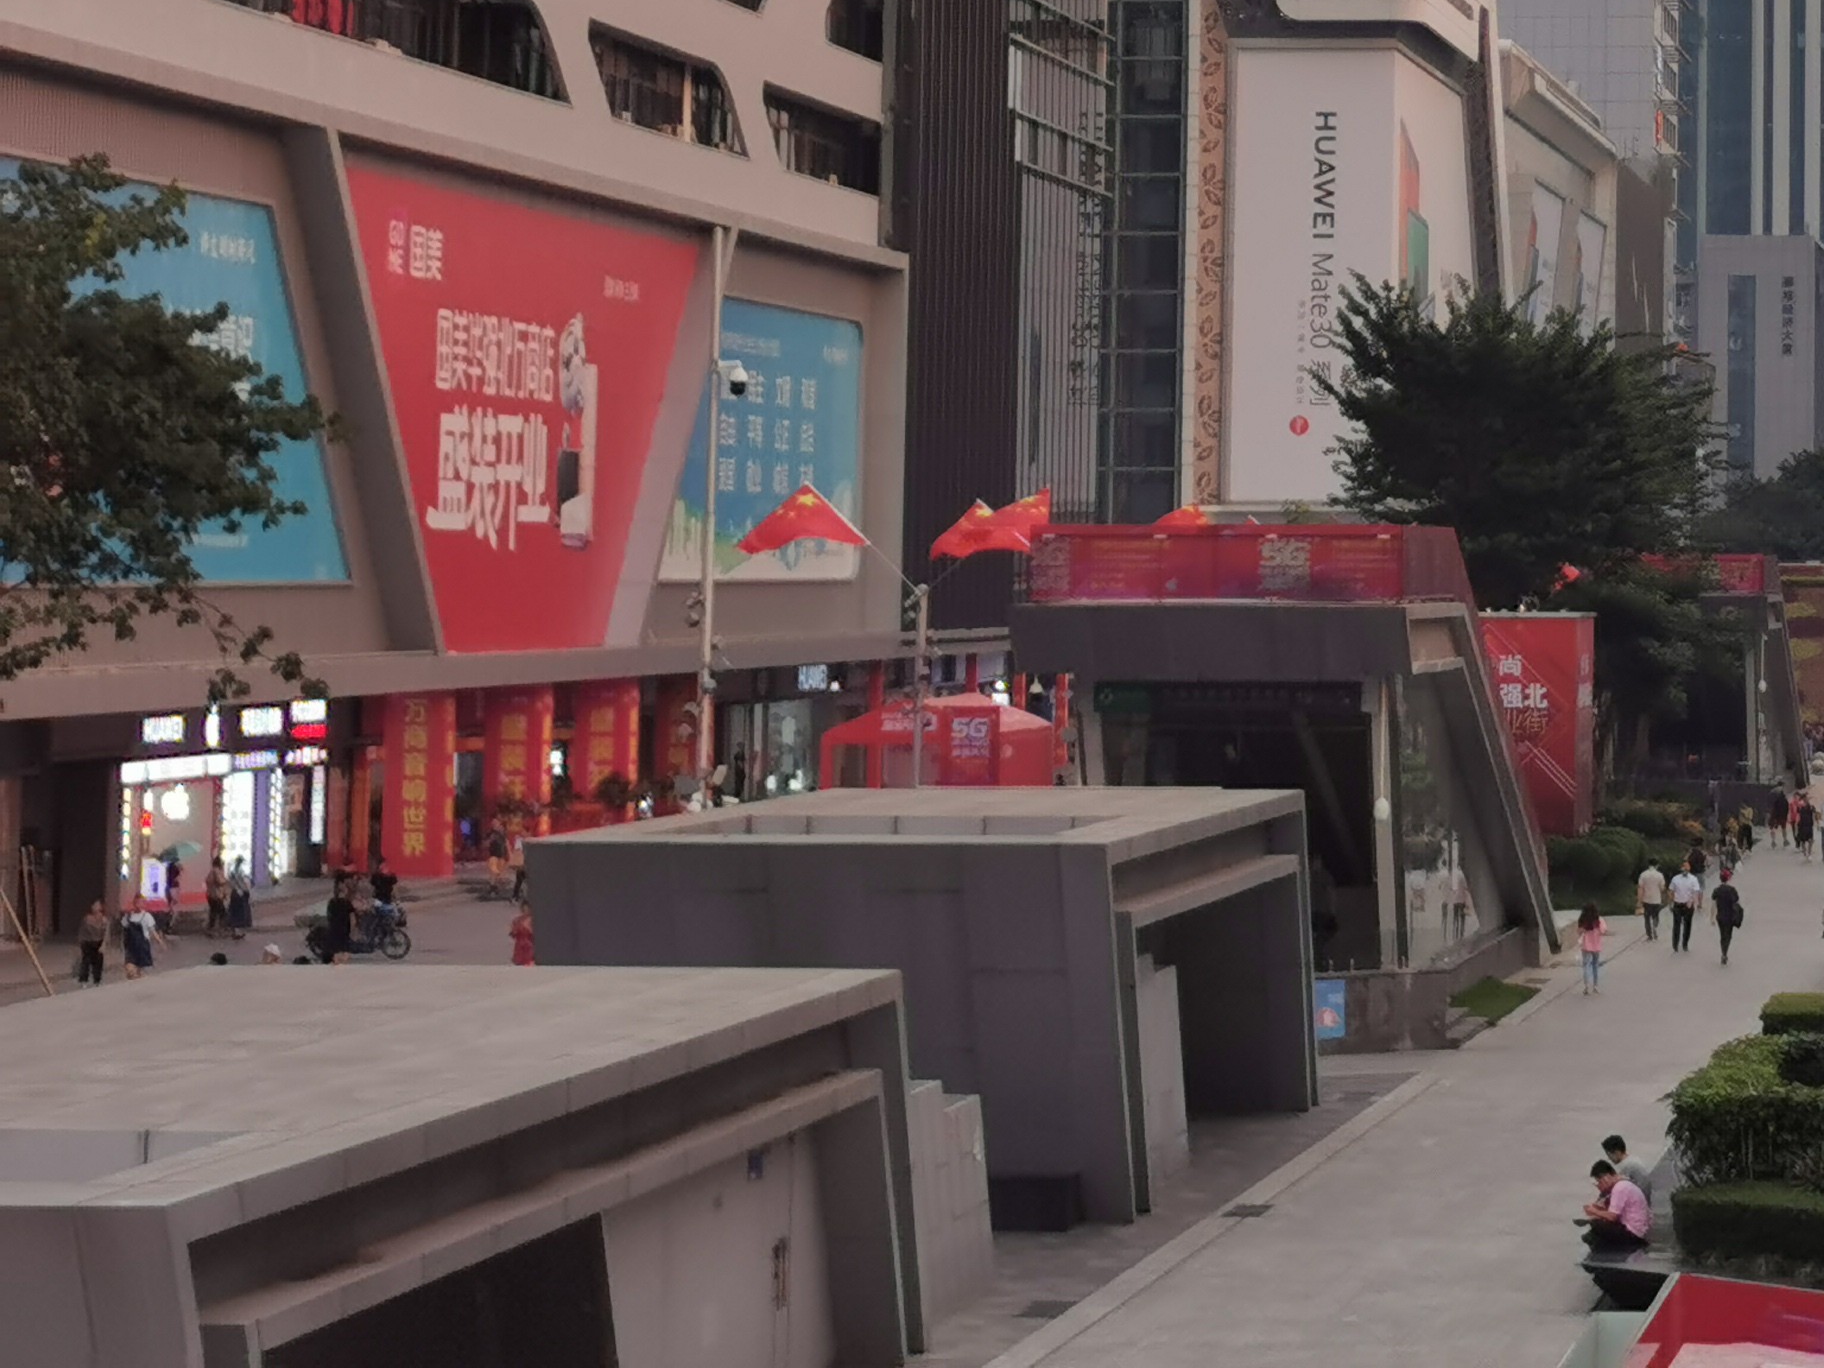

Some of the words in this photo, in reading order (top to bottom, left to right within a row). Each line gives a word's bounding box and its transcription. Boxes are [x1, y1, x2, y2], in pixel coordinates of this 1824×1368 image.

[1312, 111, 1337, 240] HUAWEI
[410, 224, 443, 281] 国美
[1310, 252, 1334, 350] Mate30
[435, 308, 556, 402] 国美华强北万商店
[425, 404, 551, 550] 盛装开业
[951, 717, 991, 738] 5G
[1500, 683, 1549, 709] 强北
